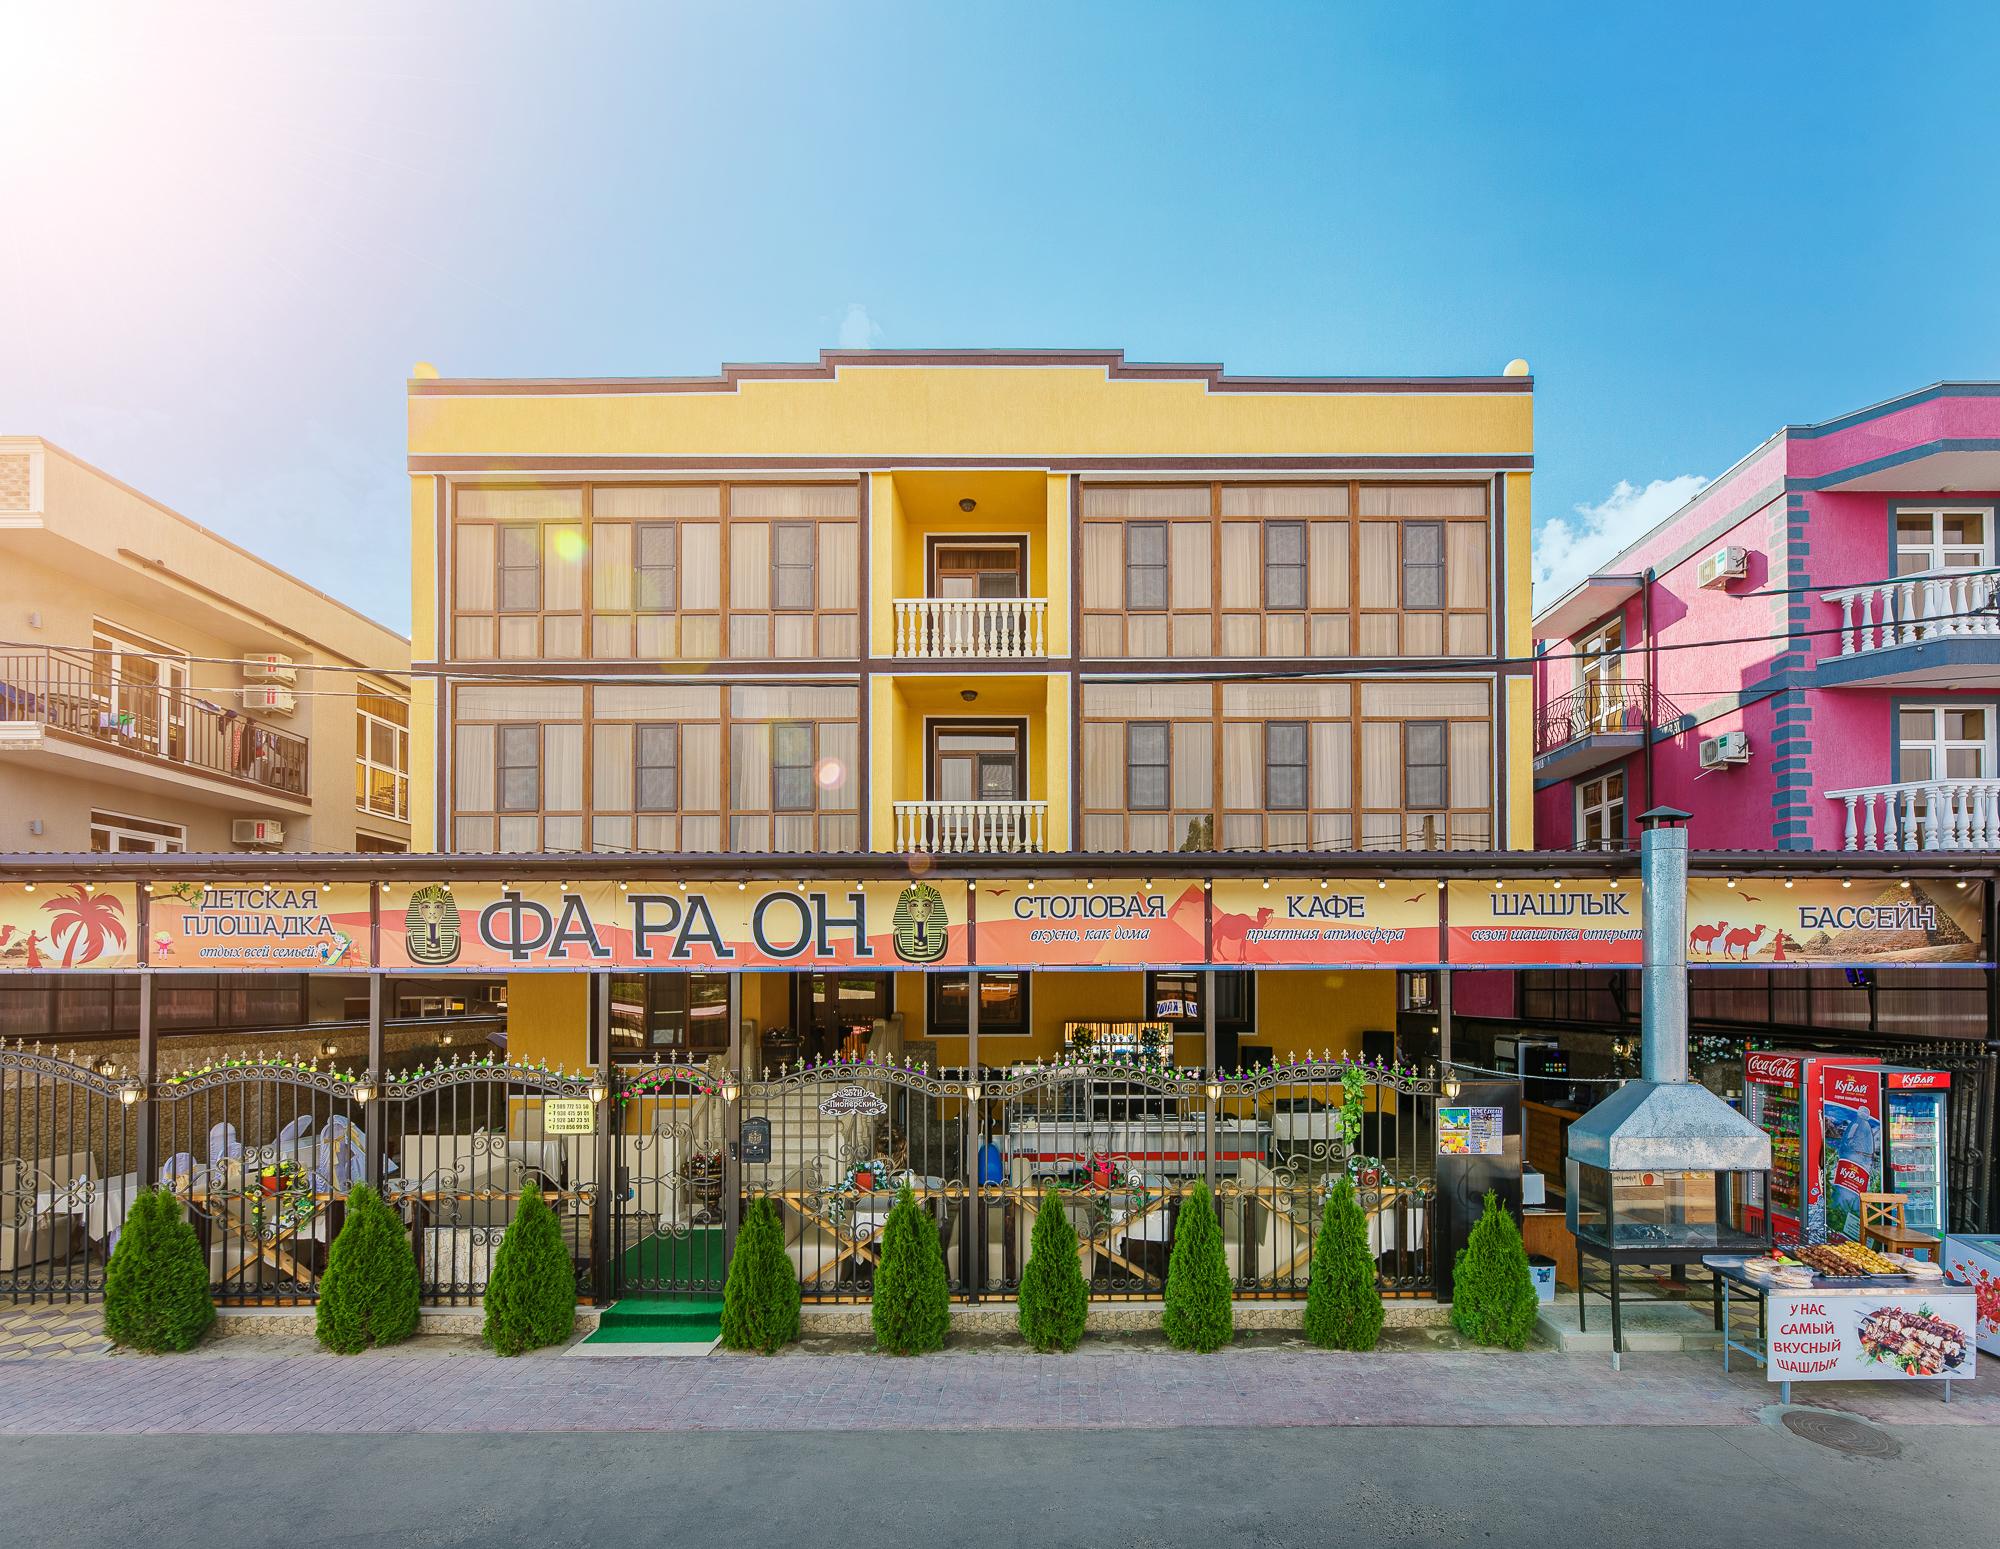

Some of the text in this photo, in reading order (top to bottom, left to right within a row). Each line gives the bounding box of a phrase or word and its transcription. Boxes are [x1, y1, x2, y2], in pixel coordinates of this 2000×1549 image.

[200, 889, 319, 912] ДЕТСКАЯ
[1014, 895, 1167, 919] СТОЛОВАЯ
[1286, 895, 1365, 919] КАФЕ
[1490, 893, 1630, 916] ШАШЛЫК
[1799, 902, 1936, 929] БАССЕЙН
[1030, 925, 1150, 943] вкусно, как дома
[1246, 927, 1405, 944] приятная атмосфера
[1471, 929, 1507, 941] сезон
[1510, 929, 1580, 941] шашлыка
[200, 945, 241, 959] отдых
[244, 944, 270, 958] всей
[1748, 1055, 1799, 1079] Coca-Cola
[830, 1099, 876, 1110] Пионерский
[1789, 1304, 1826, 1316] У НАС
[1780, 1320, 1835, 1335] САМЫЙ
[1773, 1339, 1841, 1354] ВКУСНЫЙ
[1776, 1357, 1839, 1374] ШАШЛЫК
